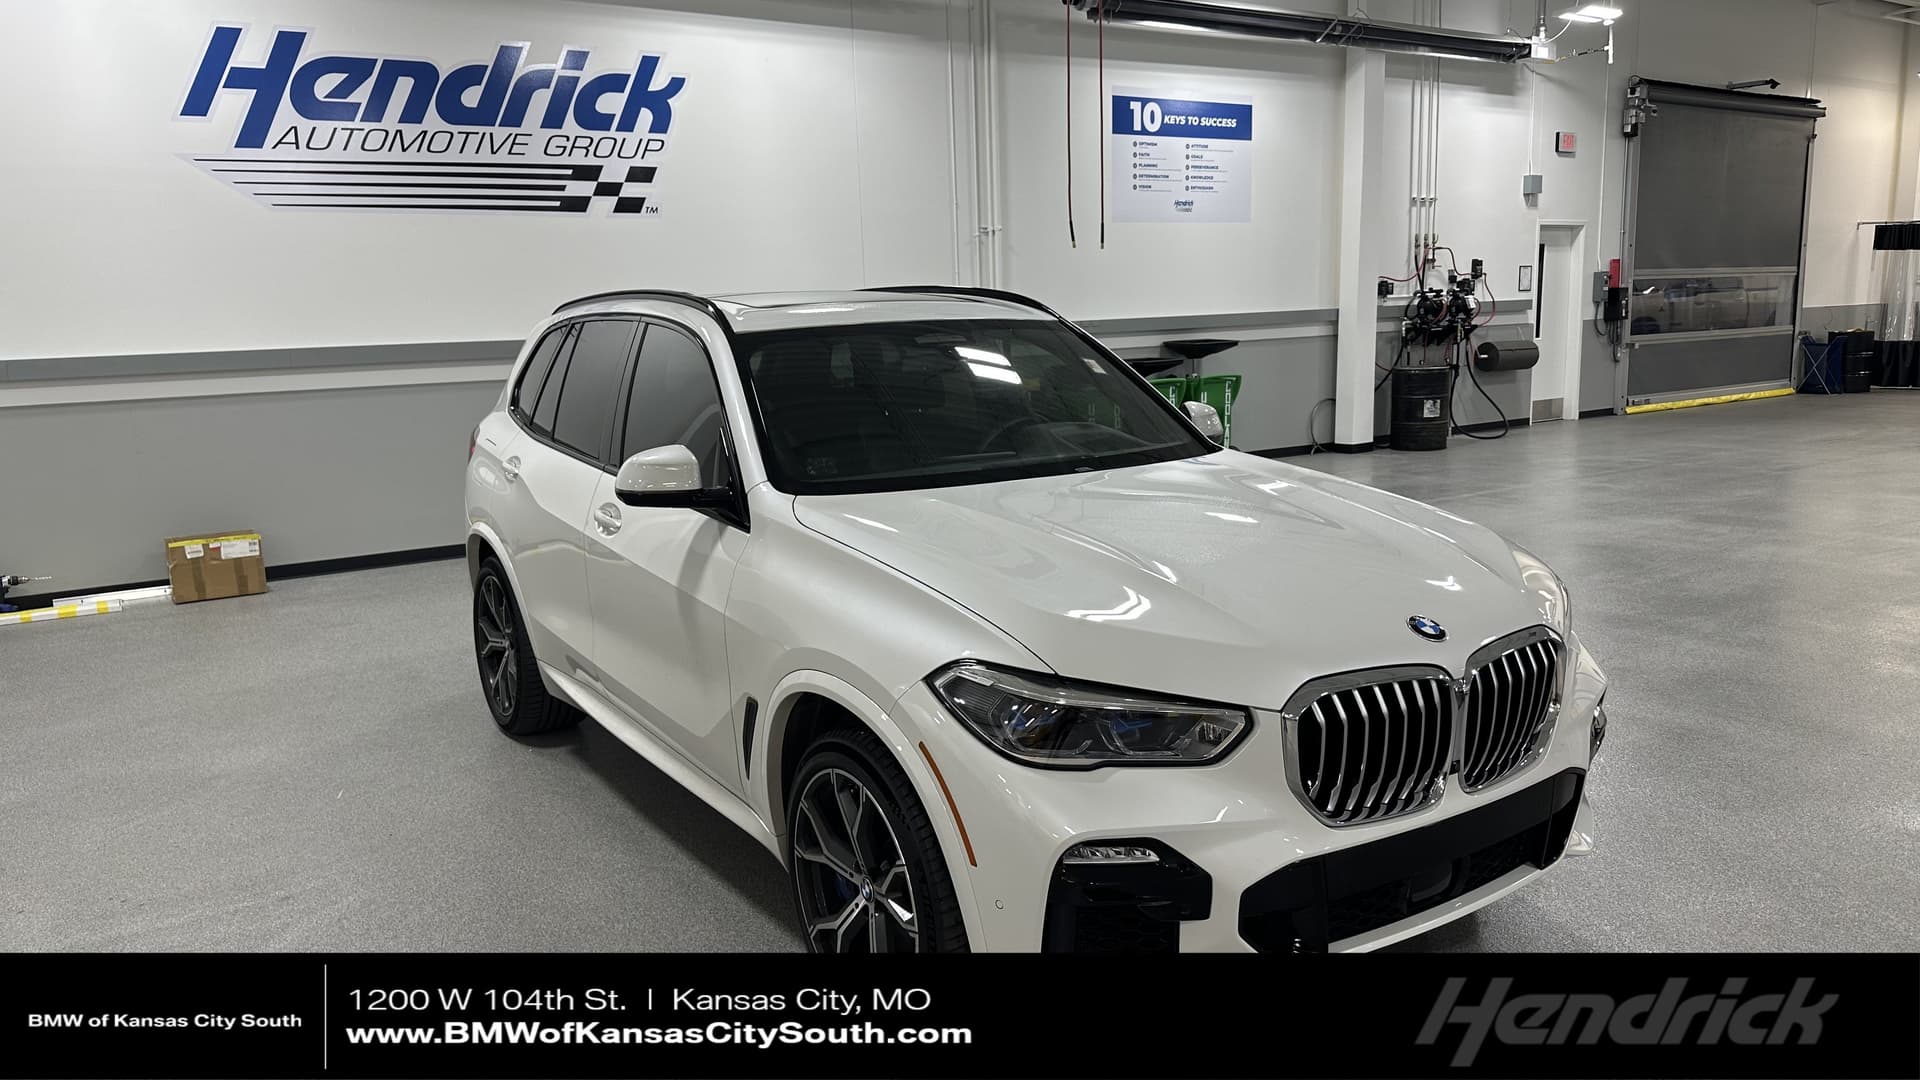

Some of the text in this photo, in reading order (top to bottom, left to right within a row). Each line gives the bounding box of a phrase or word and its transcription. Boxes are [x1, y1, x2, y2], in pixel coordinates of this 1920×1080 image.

[180, 26, 686, 149] Hendrick
[1130, 101, 1237, 132] 10 KEYS TO SUCCESS
[272, 126, 665, 160] AUTOMOTIVE GROUP
